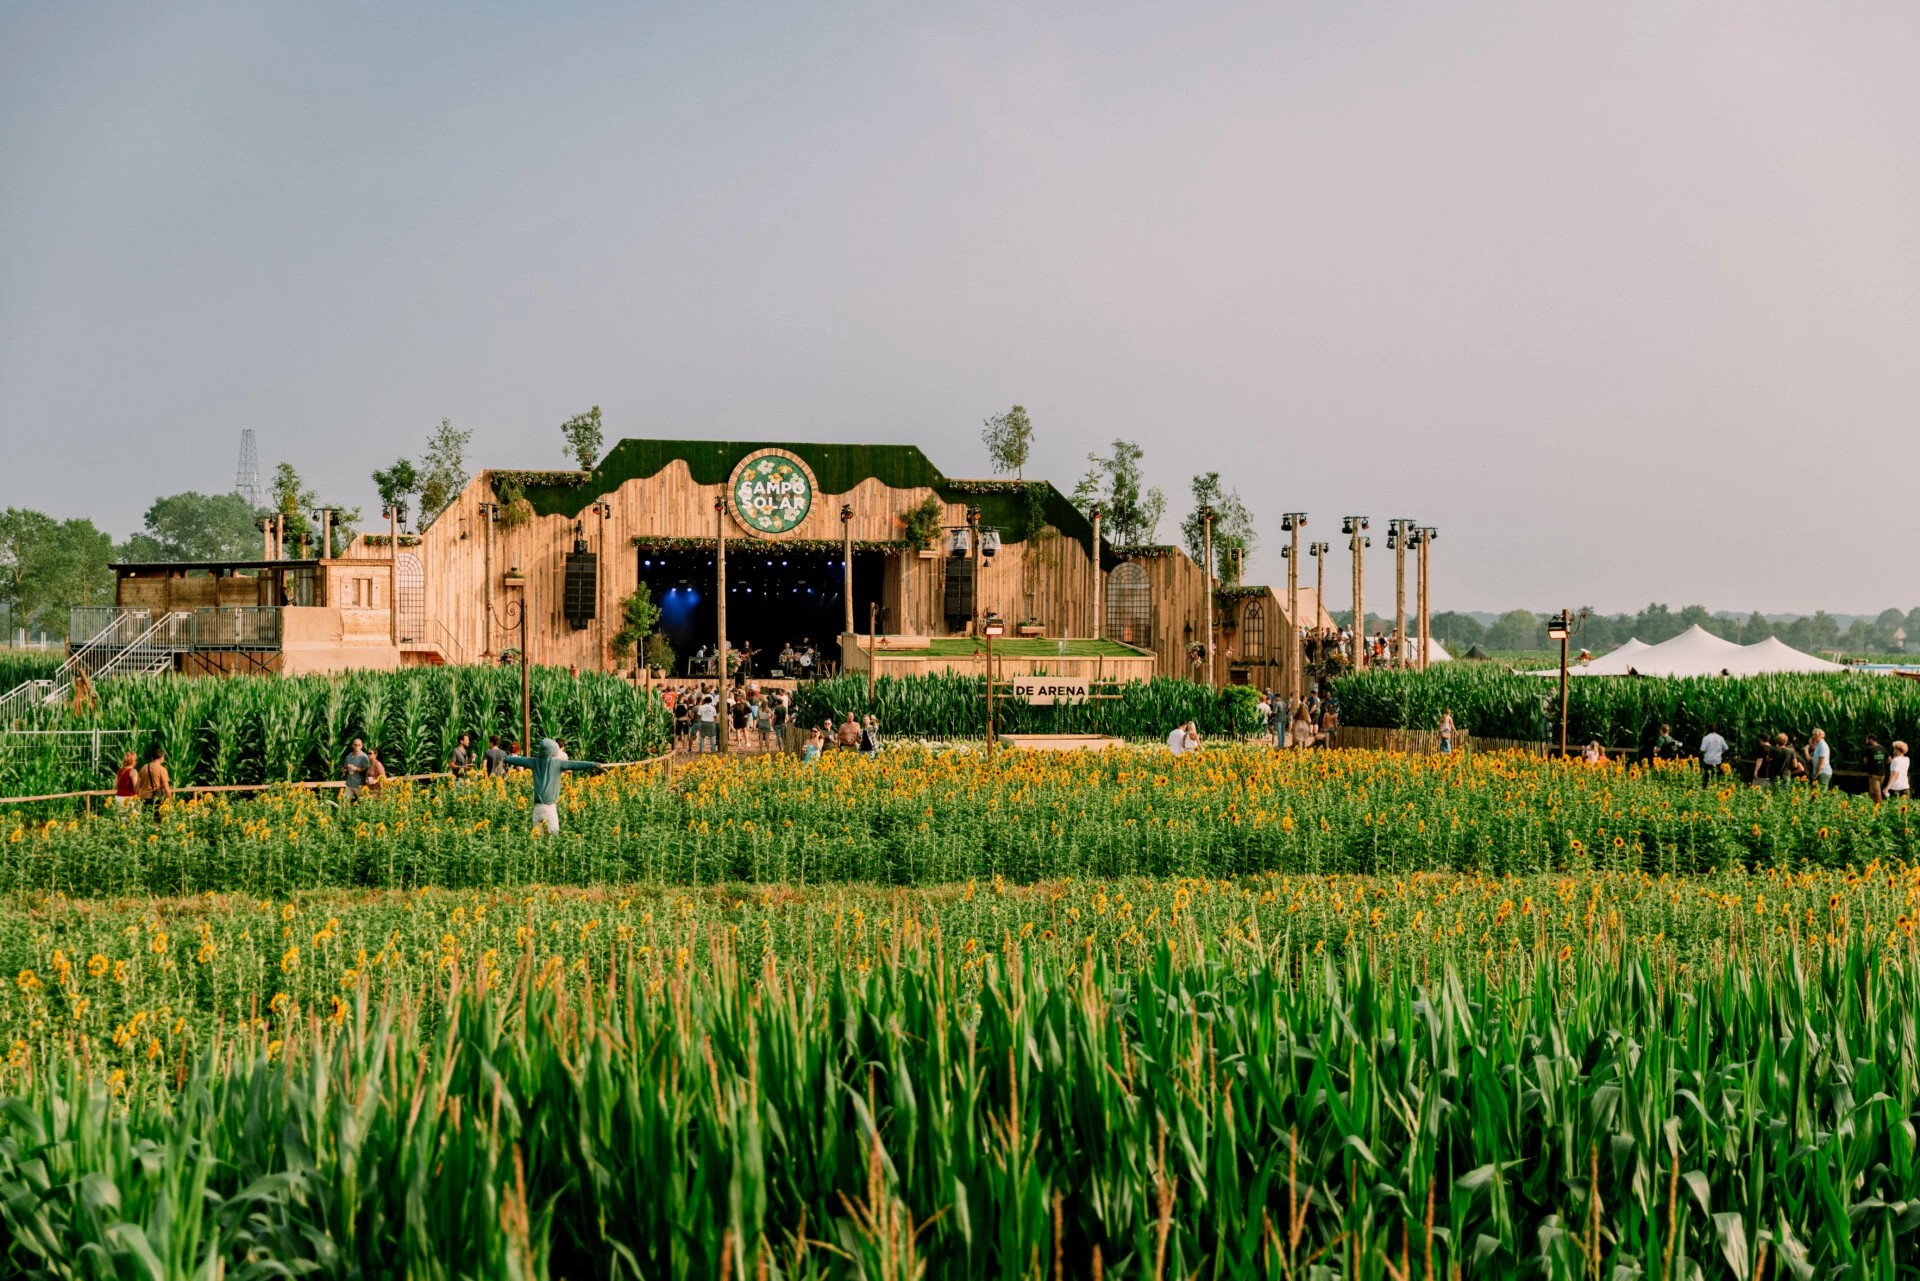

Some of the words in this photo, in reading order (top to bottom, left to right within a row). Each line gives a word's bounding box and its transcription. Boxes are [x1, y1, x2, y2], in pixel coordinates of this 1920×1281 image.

[740, 481, 806, 495] CAMPO
[741, 496, 805, 510] SOLAR
[1016, 686, 1034, 696] DE
[1038, 686, 1086, 696] ARENA
